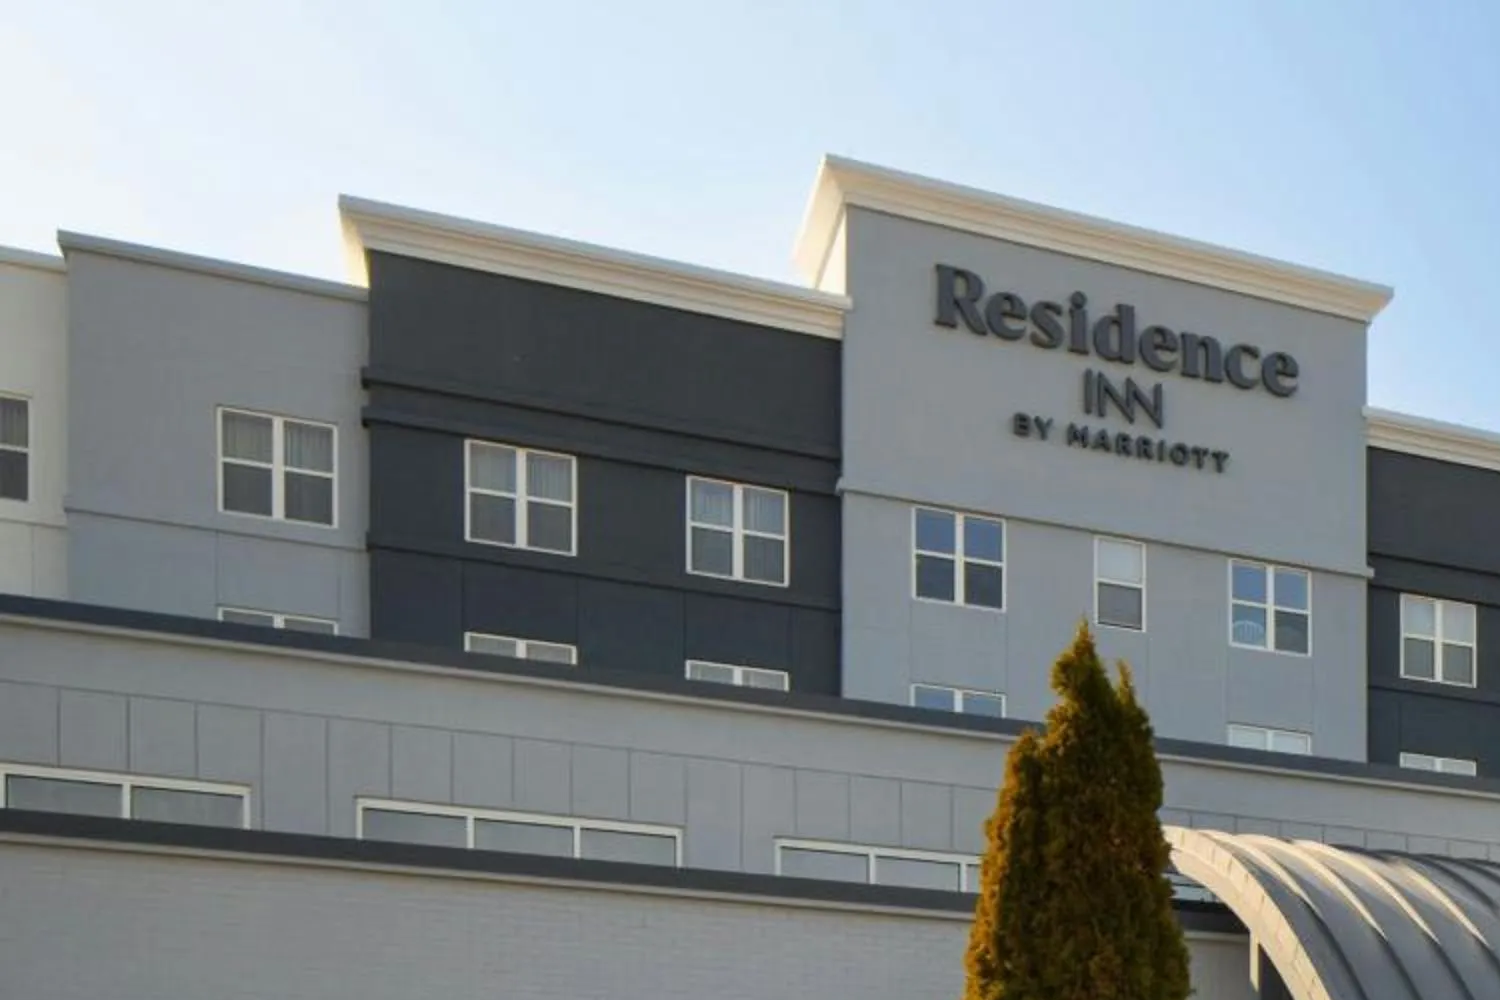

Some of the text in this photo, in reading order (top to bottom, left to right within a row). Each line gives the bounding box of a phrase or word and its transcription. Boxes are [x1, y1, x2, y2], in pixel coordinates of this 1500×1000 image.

[934, 263, 1300, 398] Residence
[1083, 368, 1164, 429] INN
[1013, 411, 1230, 473] BY MARRIOTT
